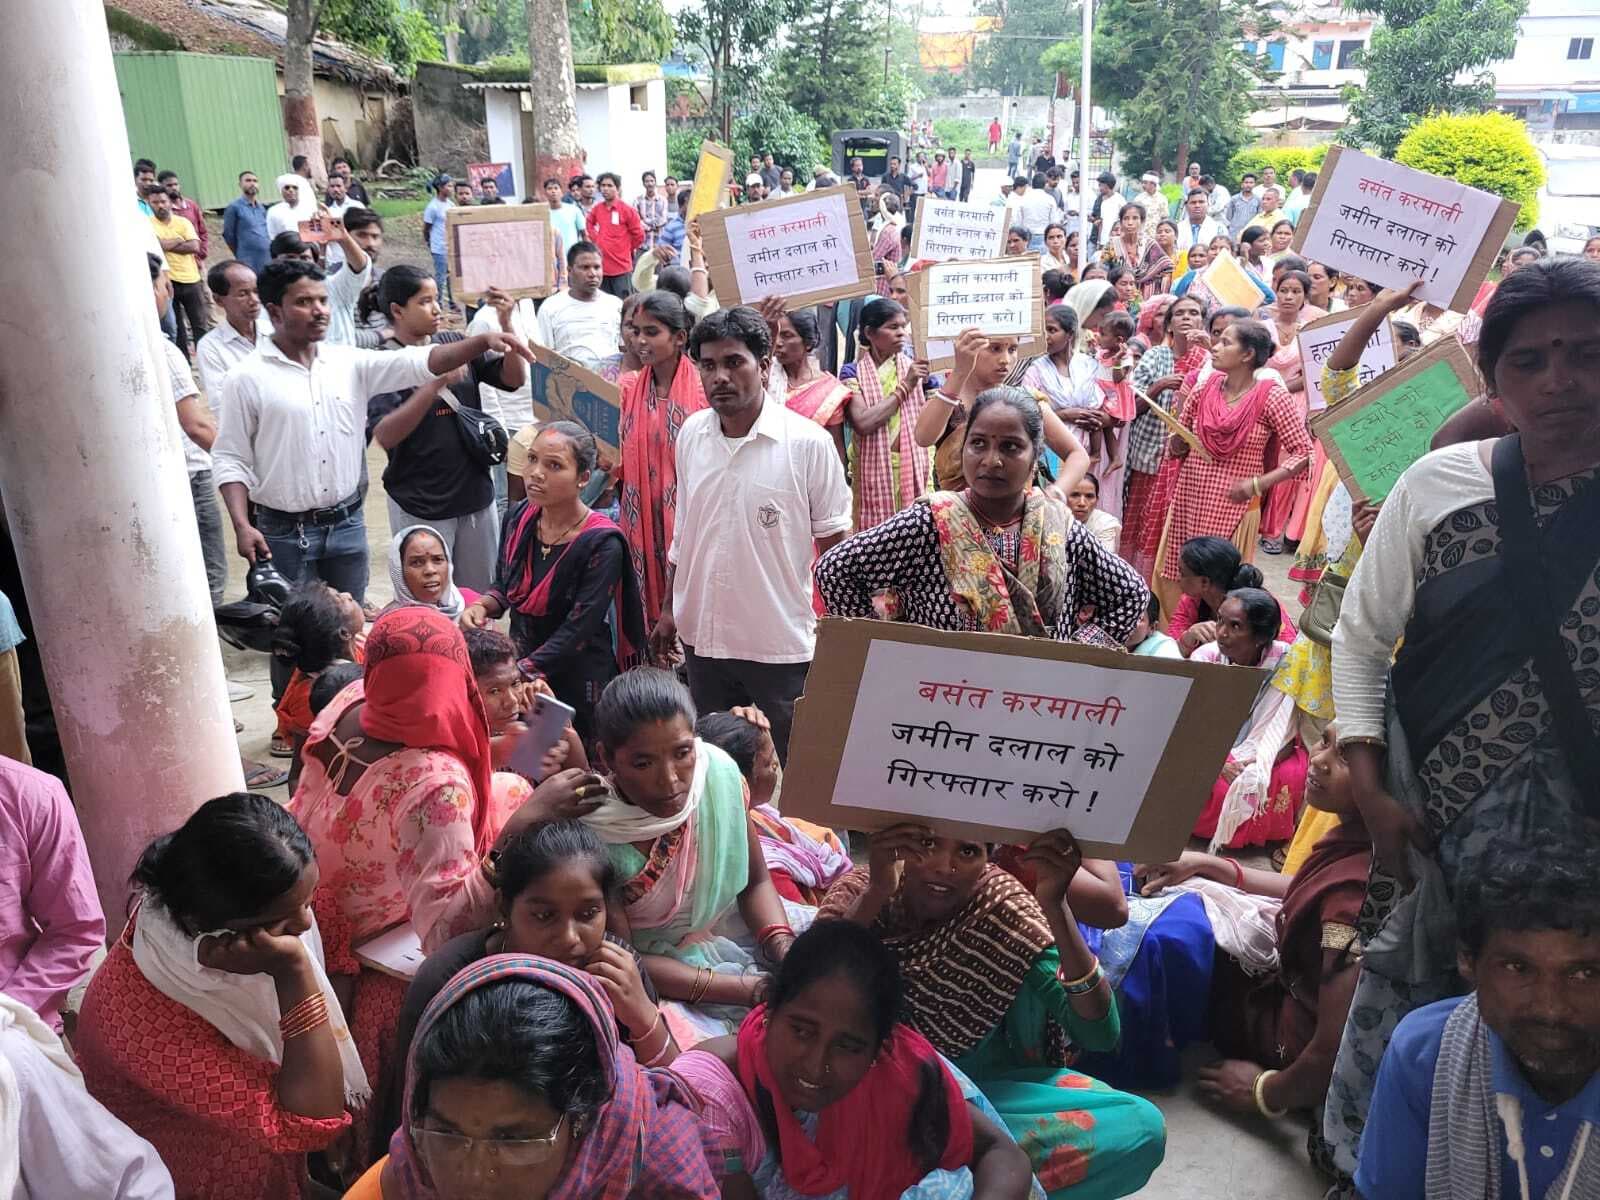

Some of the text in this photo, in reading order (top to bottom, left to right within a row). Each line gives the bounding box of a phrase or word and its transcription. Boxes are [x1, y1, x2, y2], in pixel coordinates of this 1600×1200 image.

[1358, 178, 1464, 225] बसंत करमाली
[748, 212, 827, 240] बसंत करमाली
[1339, 203, 1457, 256] जमीन दलाल को
[747, 234, 839, 263] जमीन दलाल को
[1330, 229, 1394, 266] गिरफ्तार
[753, 268, 804, 287] गिरफ्तार
[943, 269, 1018, 284] बसंत करमाली
[936, 288, 1025, 304] जमीन दलाल को
[936, 311, 985, 325] गिरफ्तार
[918, 679, 1127, 726] बसंत करमाली
[891, 720, 1125, 772] जमीन दलाल को
[887, 758, 1014, 800] गिरफ्तार
